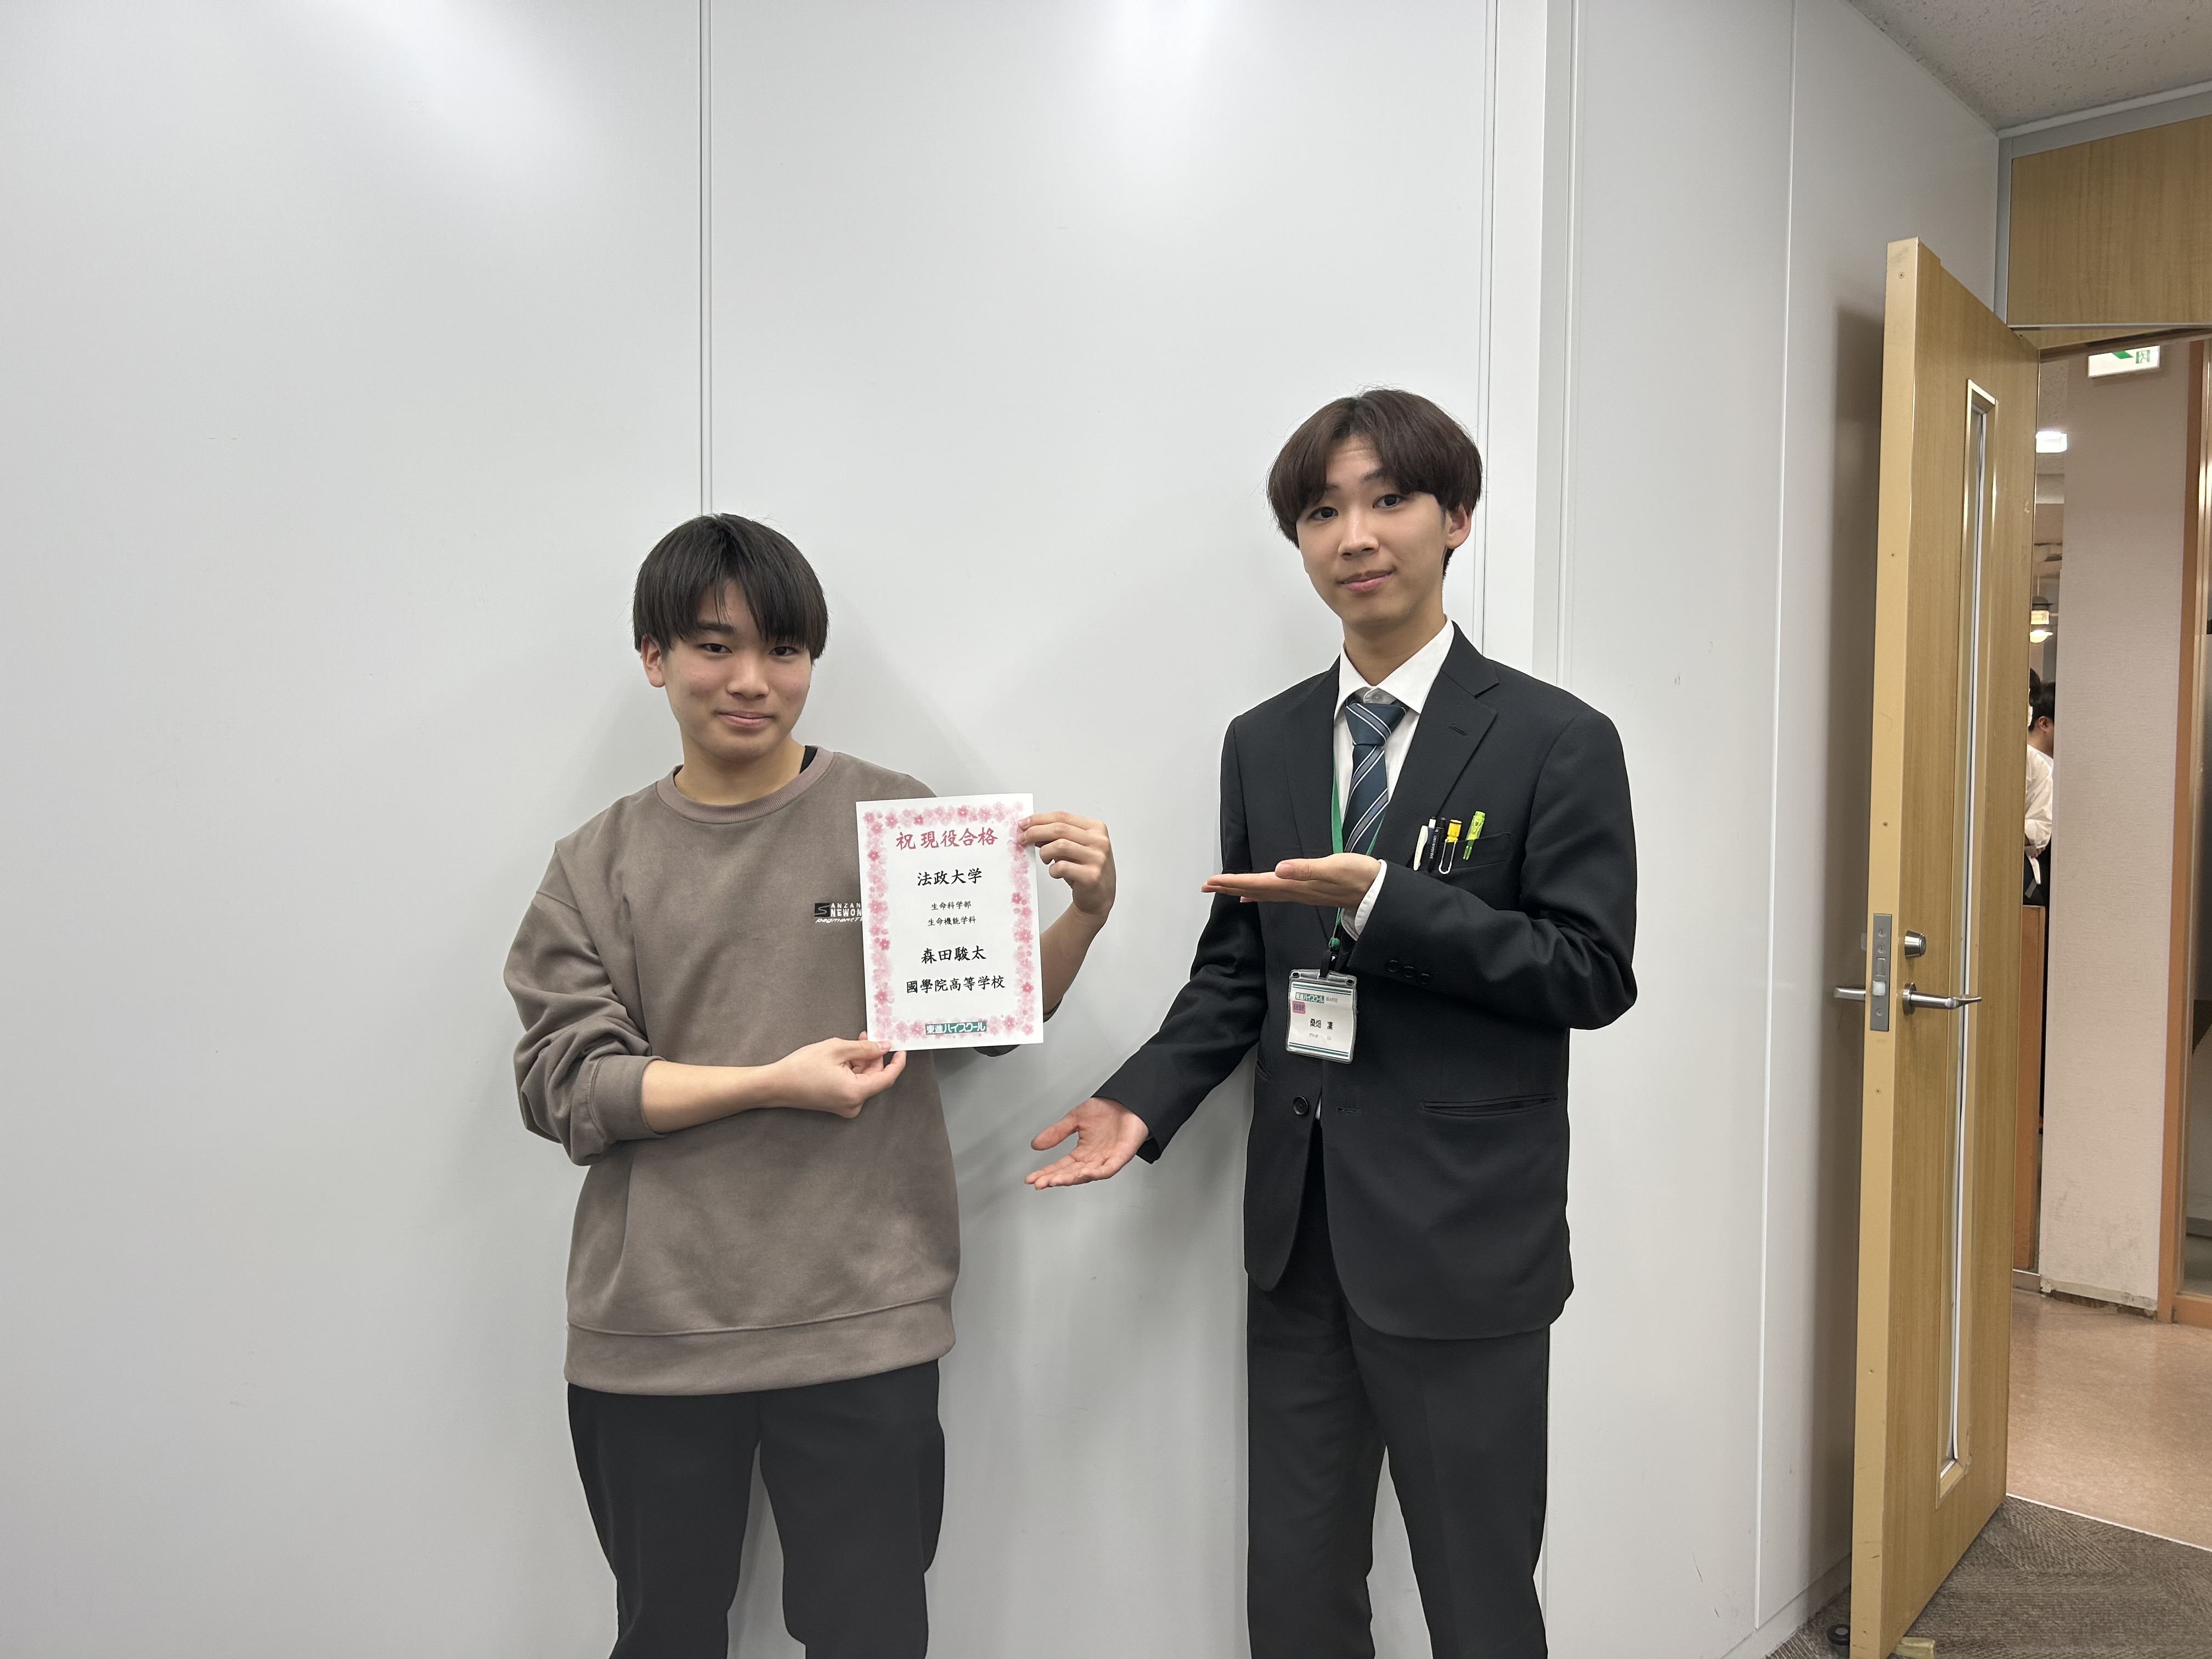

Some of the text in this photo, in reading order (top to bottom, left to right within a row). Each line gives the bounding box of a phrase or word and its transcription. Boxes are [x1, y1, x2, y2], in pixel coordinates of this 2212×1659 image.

[921, 827, 998, 849] 現役合格
[917, 867, 982, 886] 法政大学
[931, 901, 972, 911] 生命科学部
[928, 916, 976, 926] 生命機能学科
[921, 945, 986, 964] 森田駿太
[906, 975, 1005, 994] 國學院高等学校
[926, 1022, 986, 1034] 東進ハイスクール
